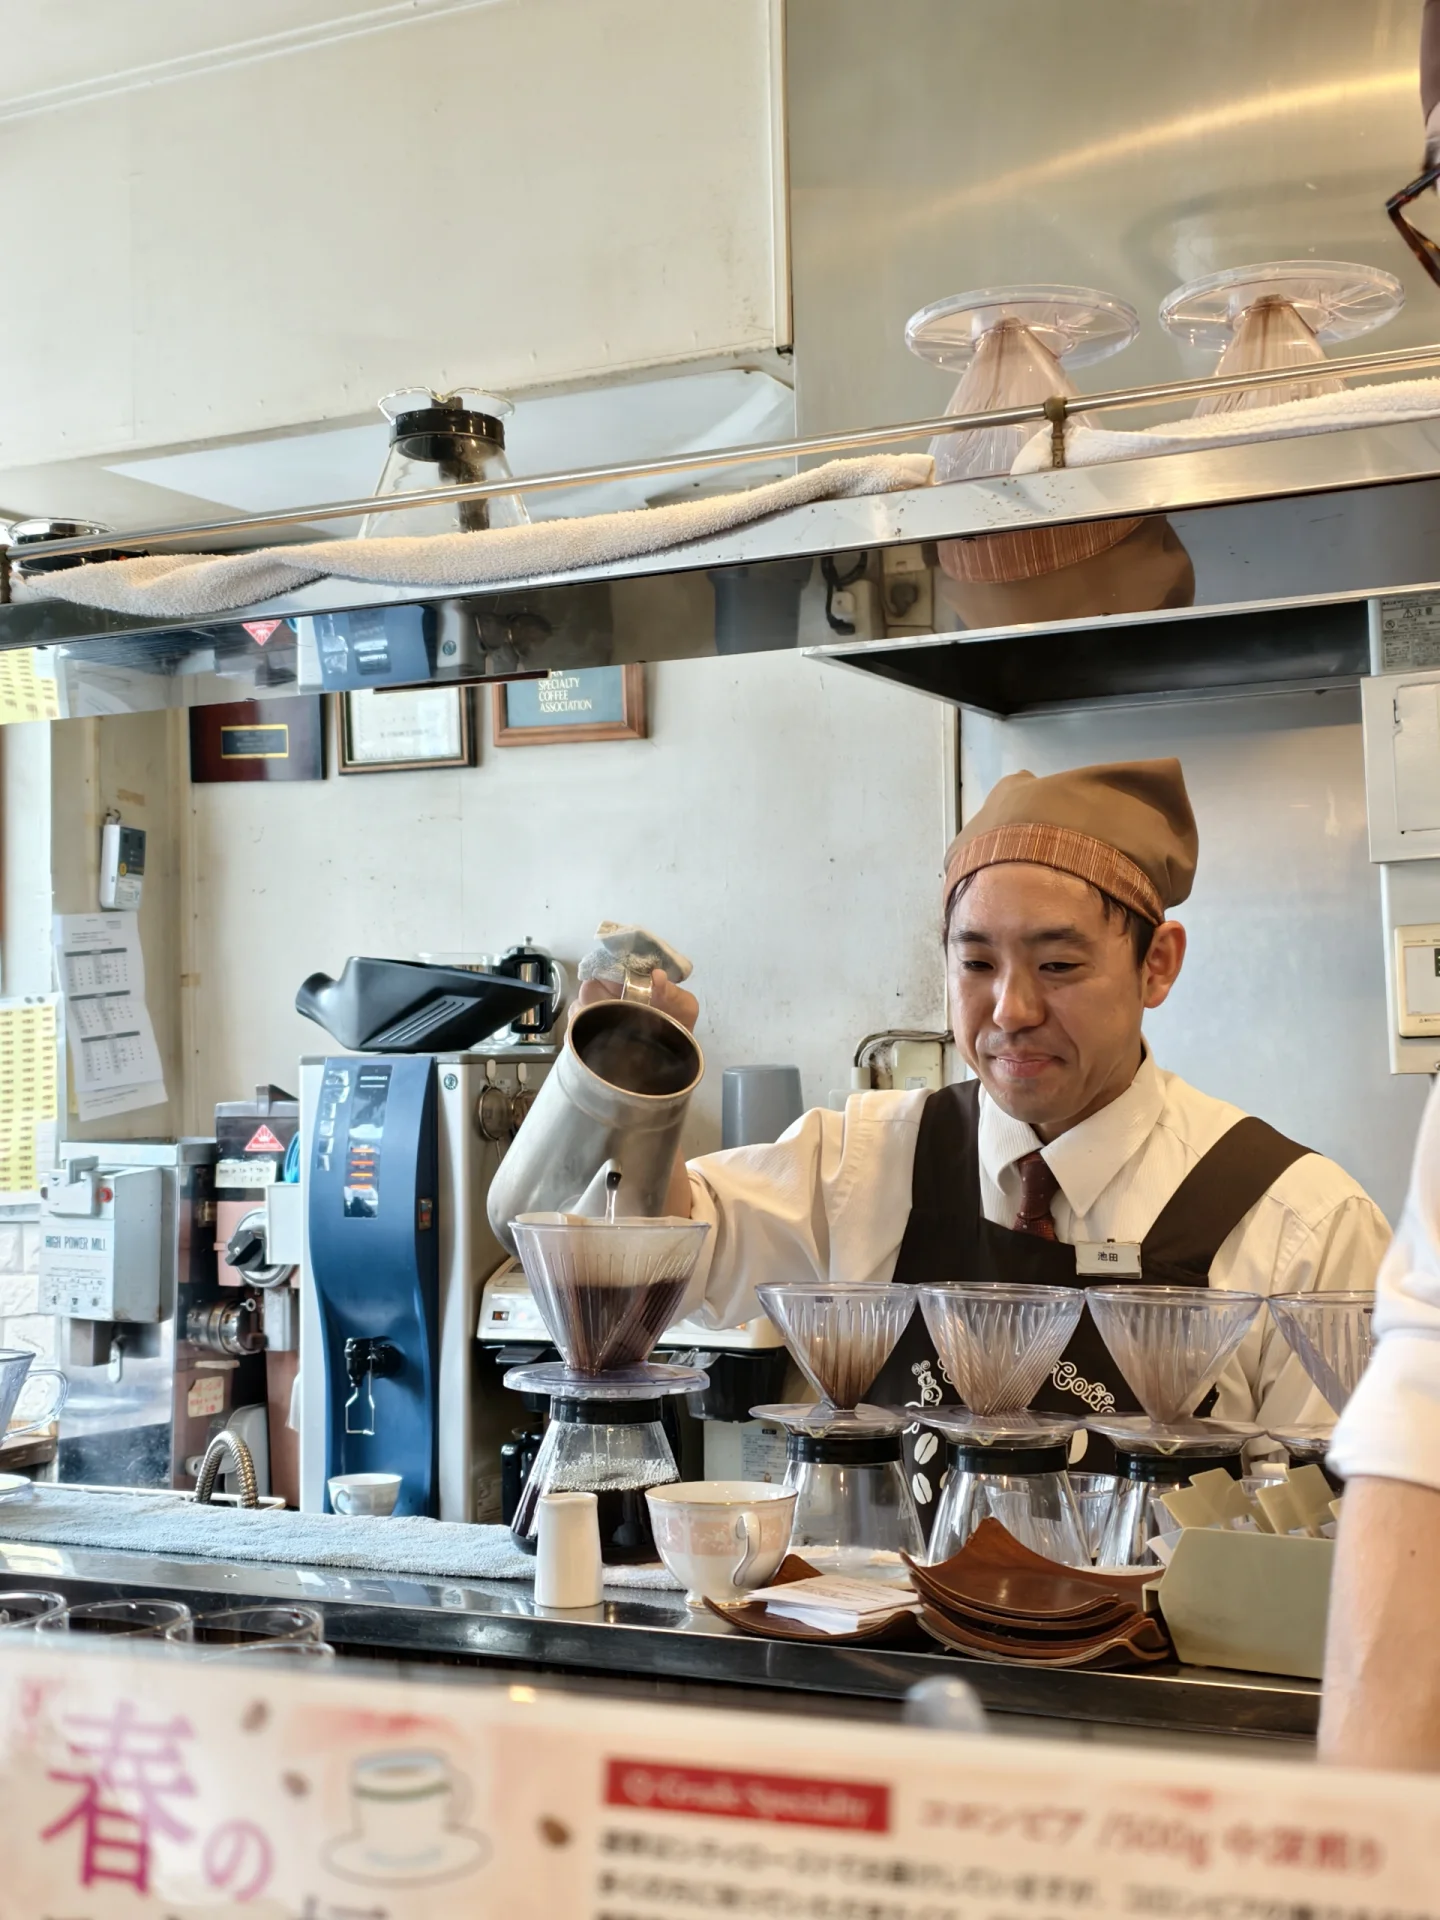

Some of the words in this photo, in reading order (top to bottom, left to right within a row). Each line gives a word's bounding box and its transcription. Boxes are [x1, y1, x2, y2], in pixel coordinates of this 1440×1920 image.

[538, 678, 580, 691] SPECIALTY
[538, 689, 569, 702] COFFEE
[540, 700, 593, 713] ASSOCIATION
[45, 1235, 61, 1249] HIGH
[64, 1236, 88, 1250] POWER
[91, 1237, 107, 1251] MILL
[1097, 1251, 1119, 1262] 池田
